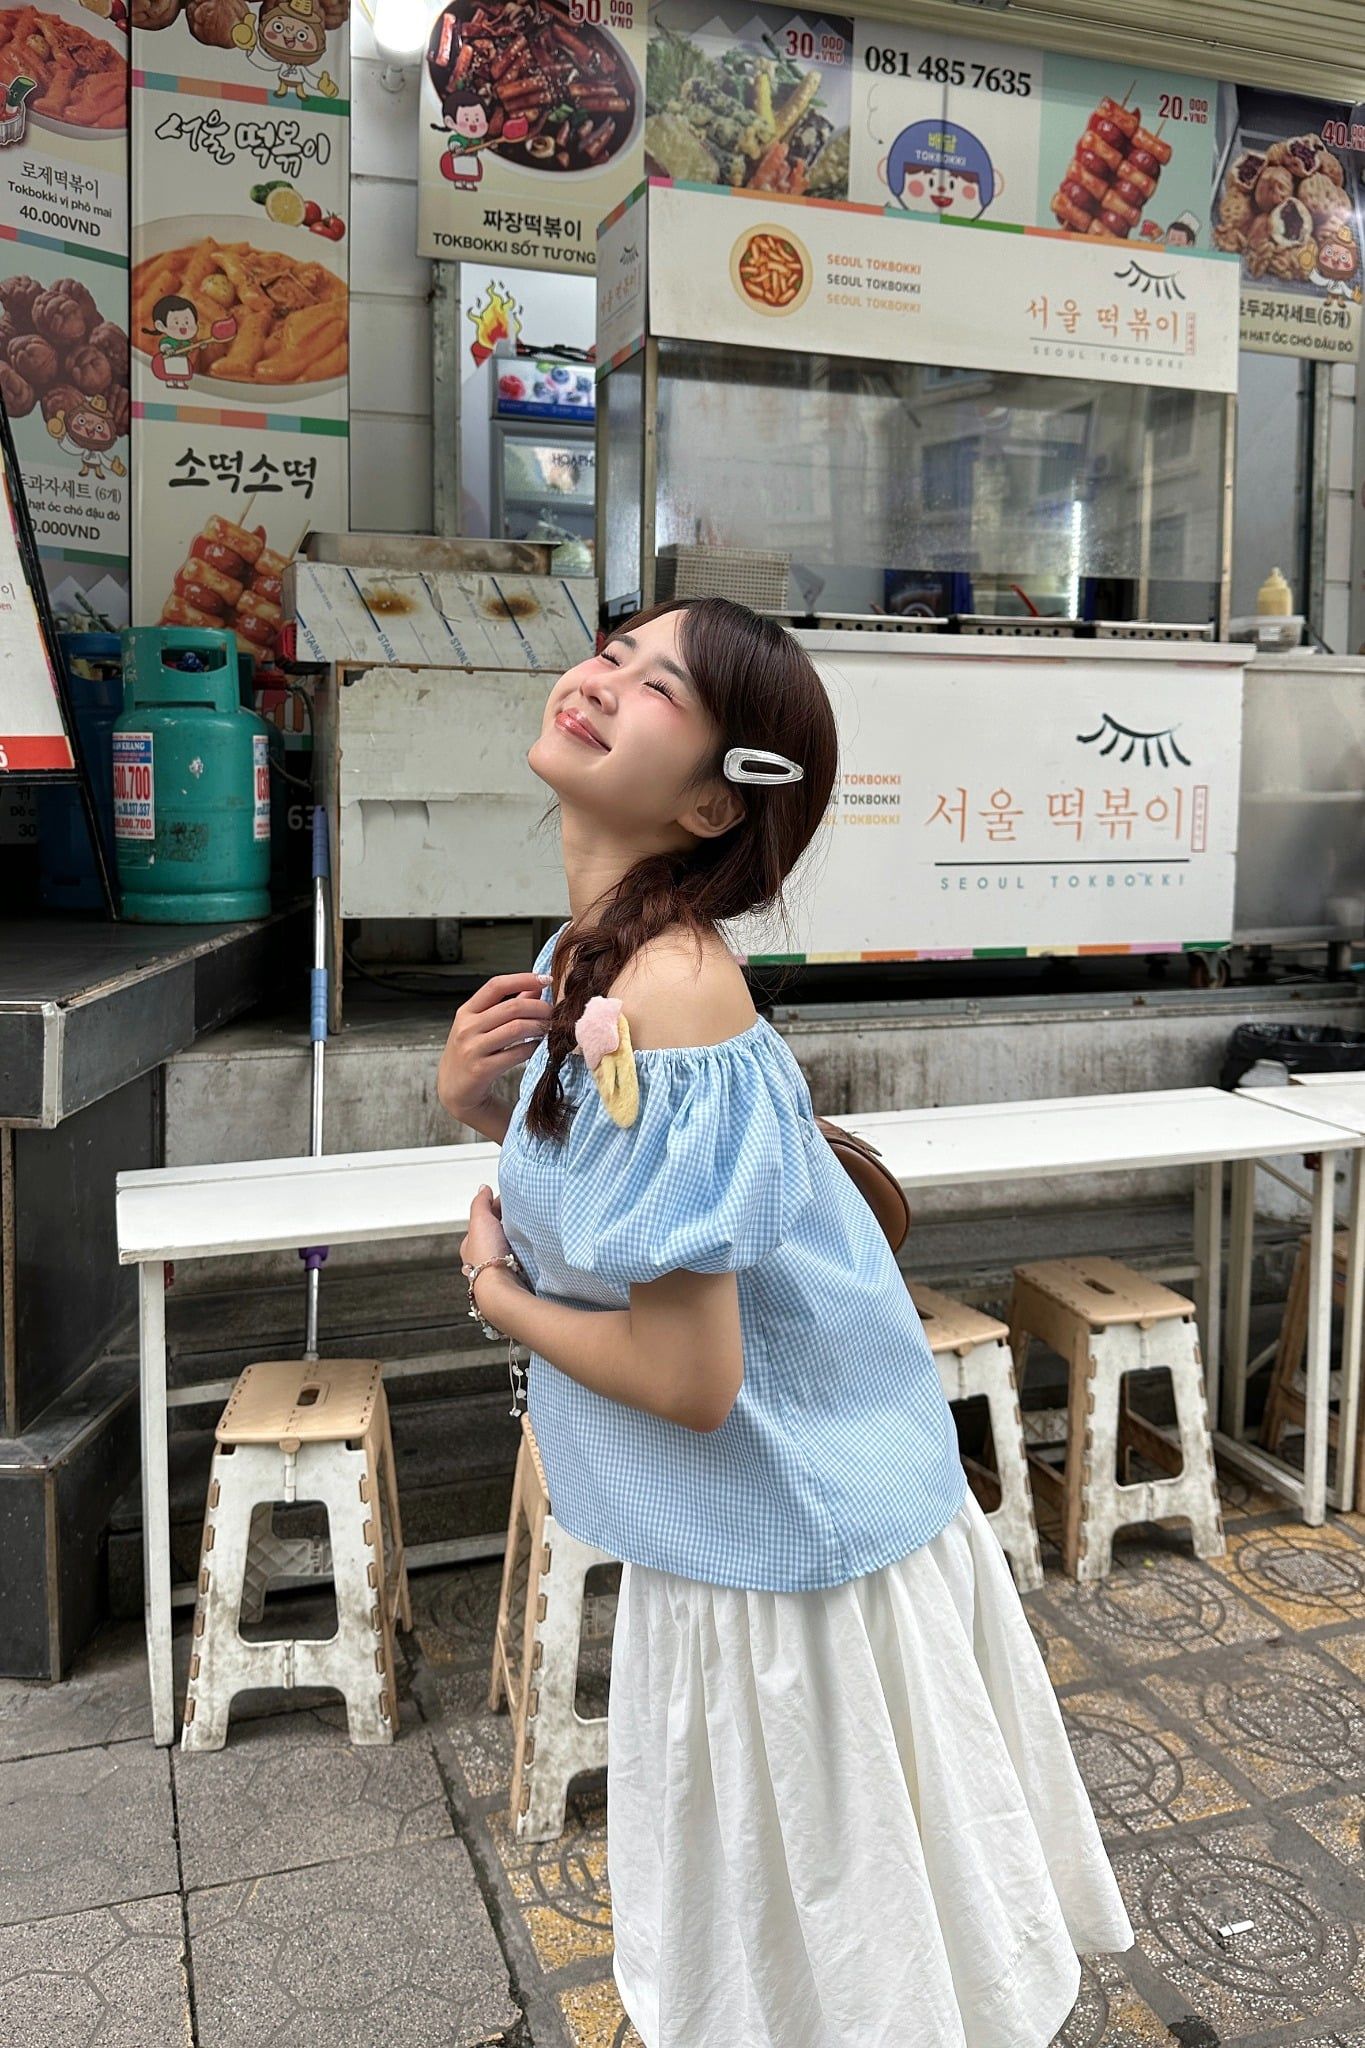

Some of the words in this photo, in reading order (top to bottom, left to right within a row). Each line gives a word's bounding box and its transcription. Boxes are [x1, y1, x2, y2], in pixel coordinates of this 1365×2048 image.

[865, 46, 911, 77] 081
[917, 56, 965, 86] 485
[971, 64, 1032, 97] 7635
[155, 109, 235, 165] 서울
[235, 121, 331, 178] 떡볶이
[21, 161, 98, 199] 로제떡볶이
[8, 180, 57, 203] Tokbokki
[93, 206, 112, 219] mai
[20, 205, 101, 236] 40.000VND
[483, 209, 582, 241] 짜장떡볶이
[433, 232, 508, 254] TOKBOKKI
[511, 239, 540, 258] SỐT
[542, 248, 596, 264] TƯƠNG
[827, 254, 862, 268] SEOUL
[866, 258, 921, 275] TOKBOKKI
[827, 274, 862, 288] SEOUL
[866, 278, 921, 294] TOKBOKKI
[827, 293, 862, 308] SEOUL
[866, 297, 921, 313] TOKBOKKI
[1026, 295, 1081, 334] 서울
[1096, 304, 1179, 345] 떡볶이
[1033, 345, 1086, 360] SEOUL
[168, 447, 317, 499] 소떡소떡
[843, 774, 902, 785] TOKBOKKI
[843, 794, 901, 805] TOKBOKKI
[925, 786, 1024, 842] 서울
[1046, 786, 1183, 842] 떡볶이
[843, 814, 900, 825] TOKBOKKI
[941, 876, 1025, 890] SEOUL
[1051, 872, 1185, 888] TOKBOKKI
